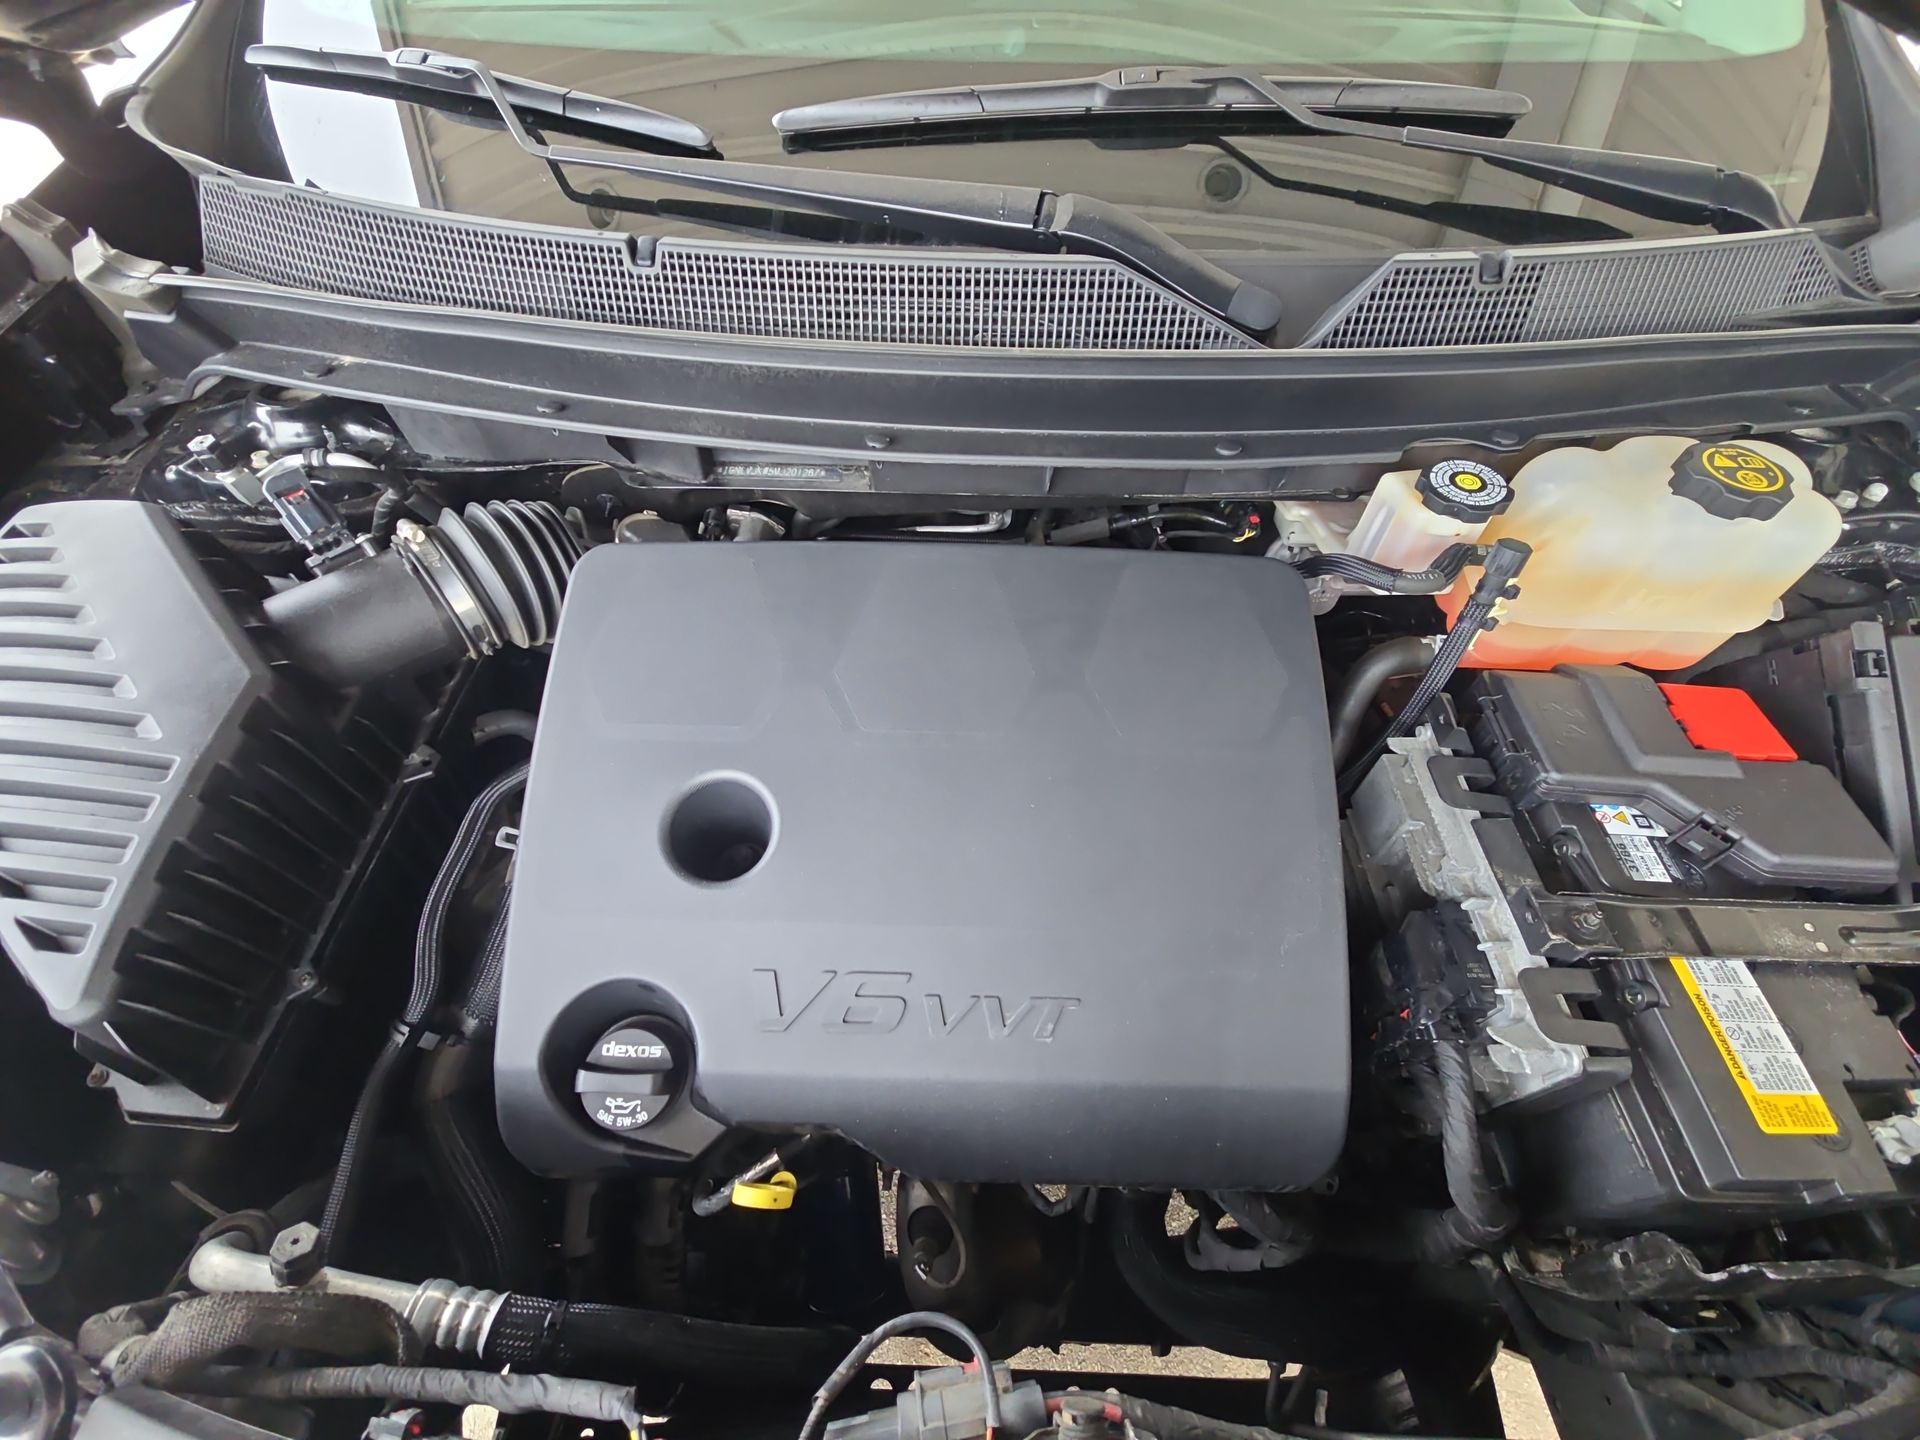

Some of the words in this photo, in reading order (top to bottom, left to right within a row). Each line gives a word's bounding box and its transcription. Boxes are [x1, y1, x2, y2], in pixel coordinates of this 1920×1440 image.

[752, 967, 913, 1034] V6
[922, 992, 1083, 1044] VVT
[601, 1041, 664, 1058] dexos
[1694, 993, 1741, 1070] DANGER/POISON
[597, 1109, 614, 1125] SAE
[616, 1111, 648, 1127] 5W-30
